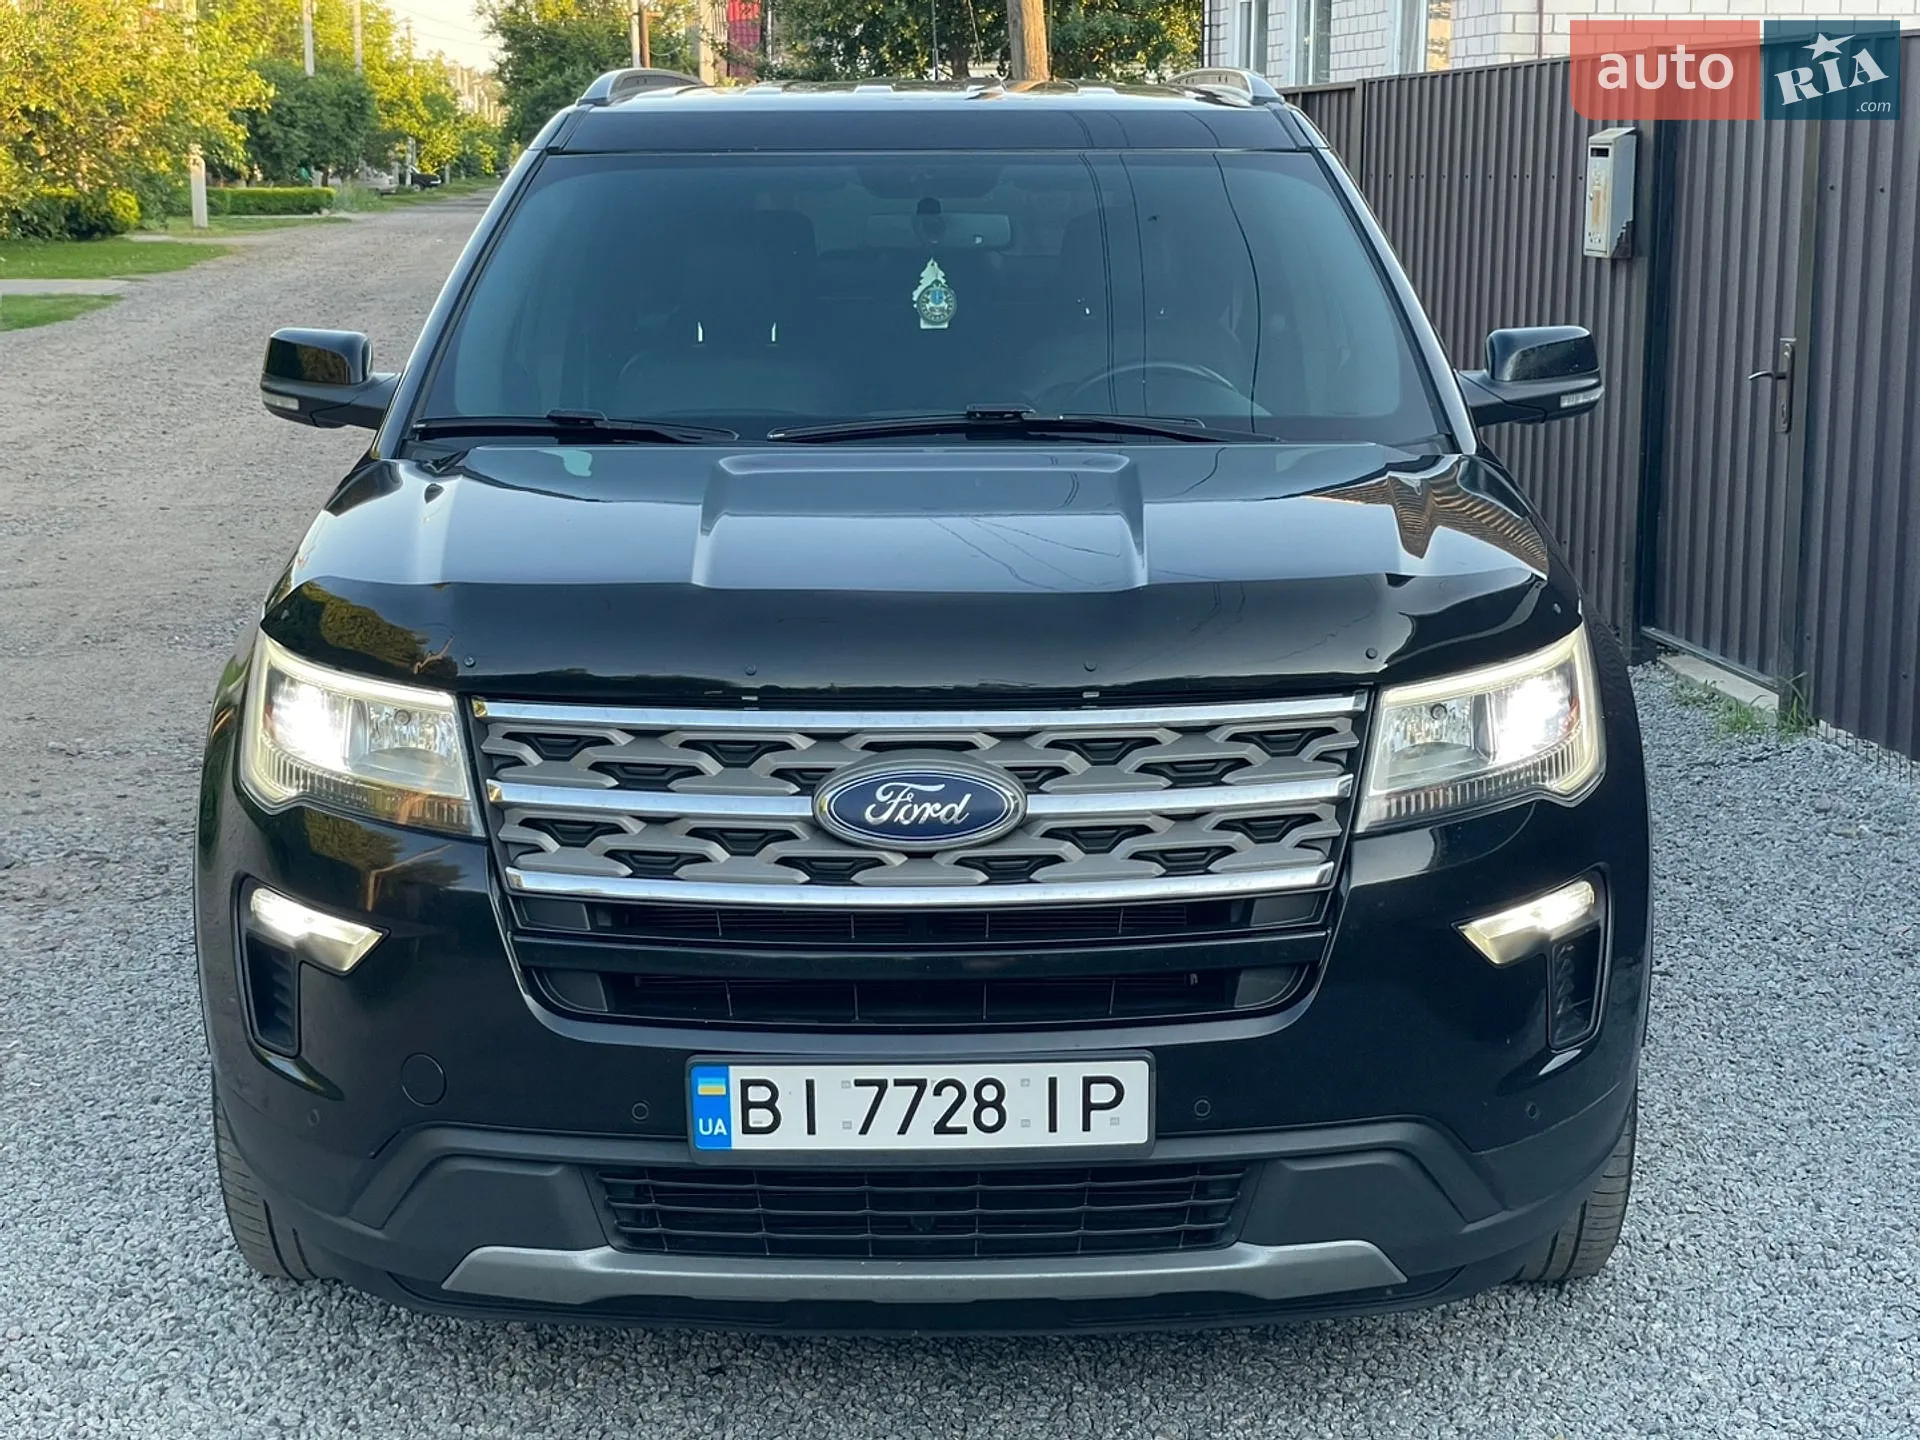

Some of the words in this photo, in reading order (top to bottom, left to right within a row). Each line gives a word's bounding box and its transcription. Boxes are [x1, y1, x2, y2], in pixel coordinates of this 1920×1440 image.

[865, 782, 972, 825] Ford
[699, 1118, 727, 1136] UA
[740, 1078, 816, 1136] BI
[853, 1077, 1007, 1135] 7728
[1048, 1076, 1125, 1133] IP
